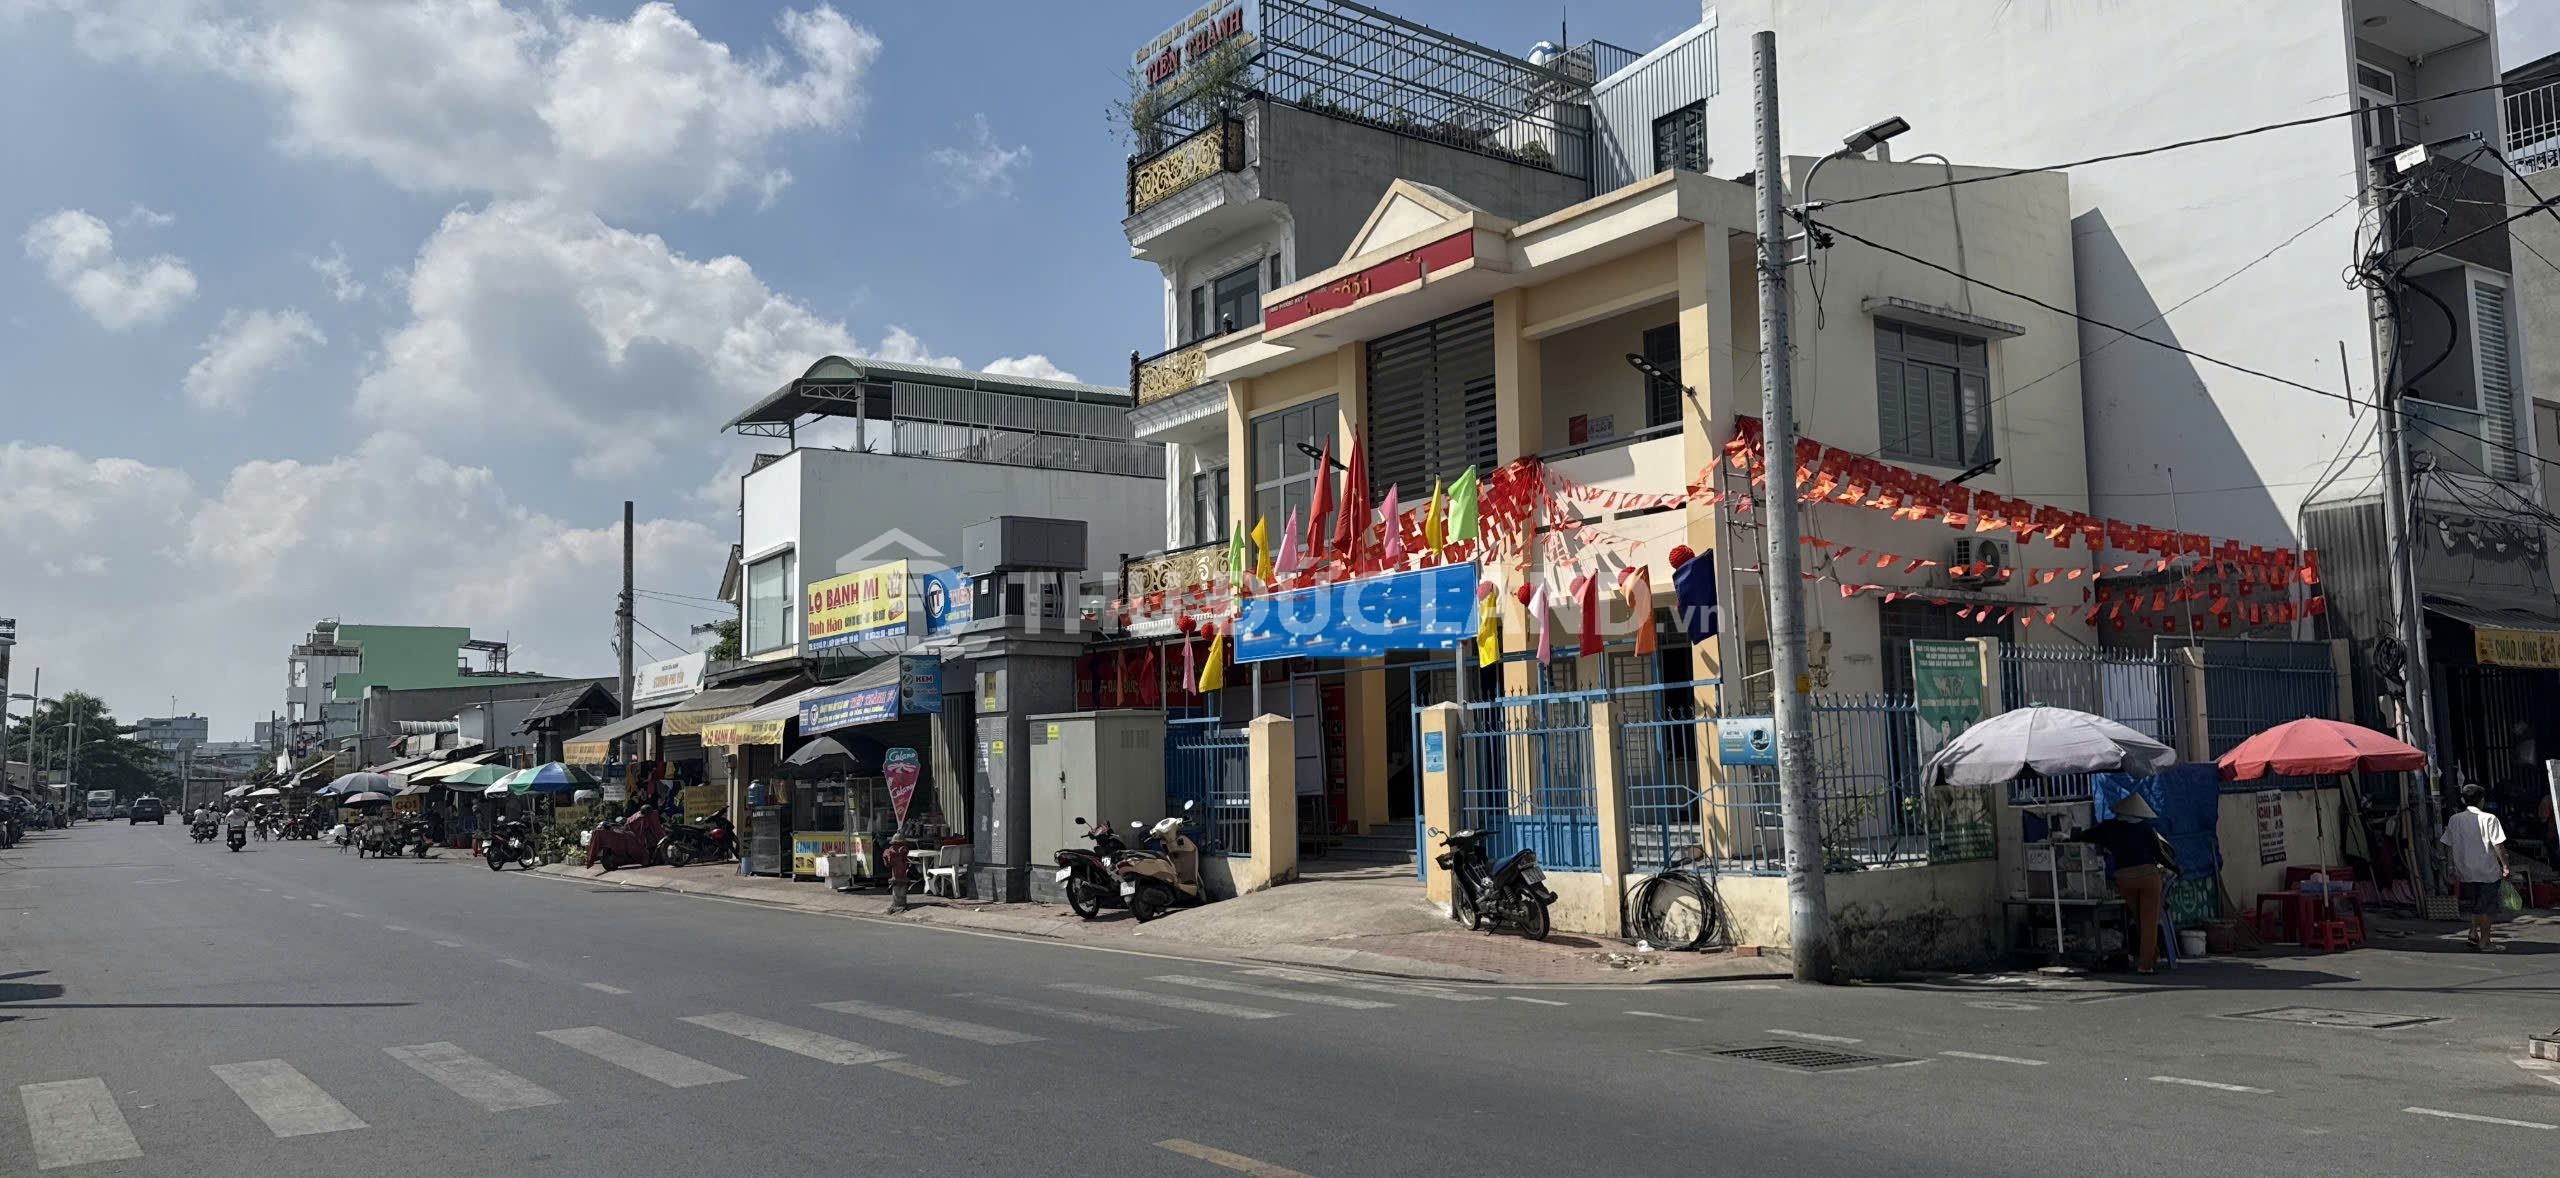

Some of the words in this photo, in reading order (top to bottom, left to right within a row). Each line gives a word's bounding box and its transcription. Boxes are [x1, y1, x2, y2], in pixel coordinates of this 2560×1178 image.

[1145, 45, 1181, 87] TIẾN
[1184, 7, 1244, 64] THÀNH
[826, 580, 859, 611] BÁNH
[2496, 634, 2516, 660] CHÁO
